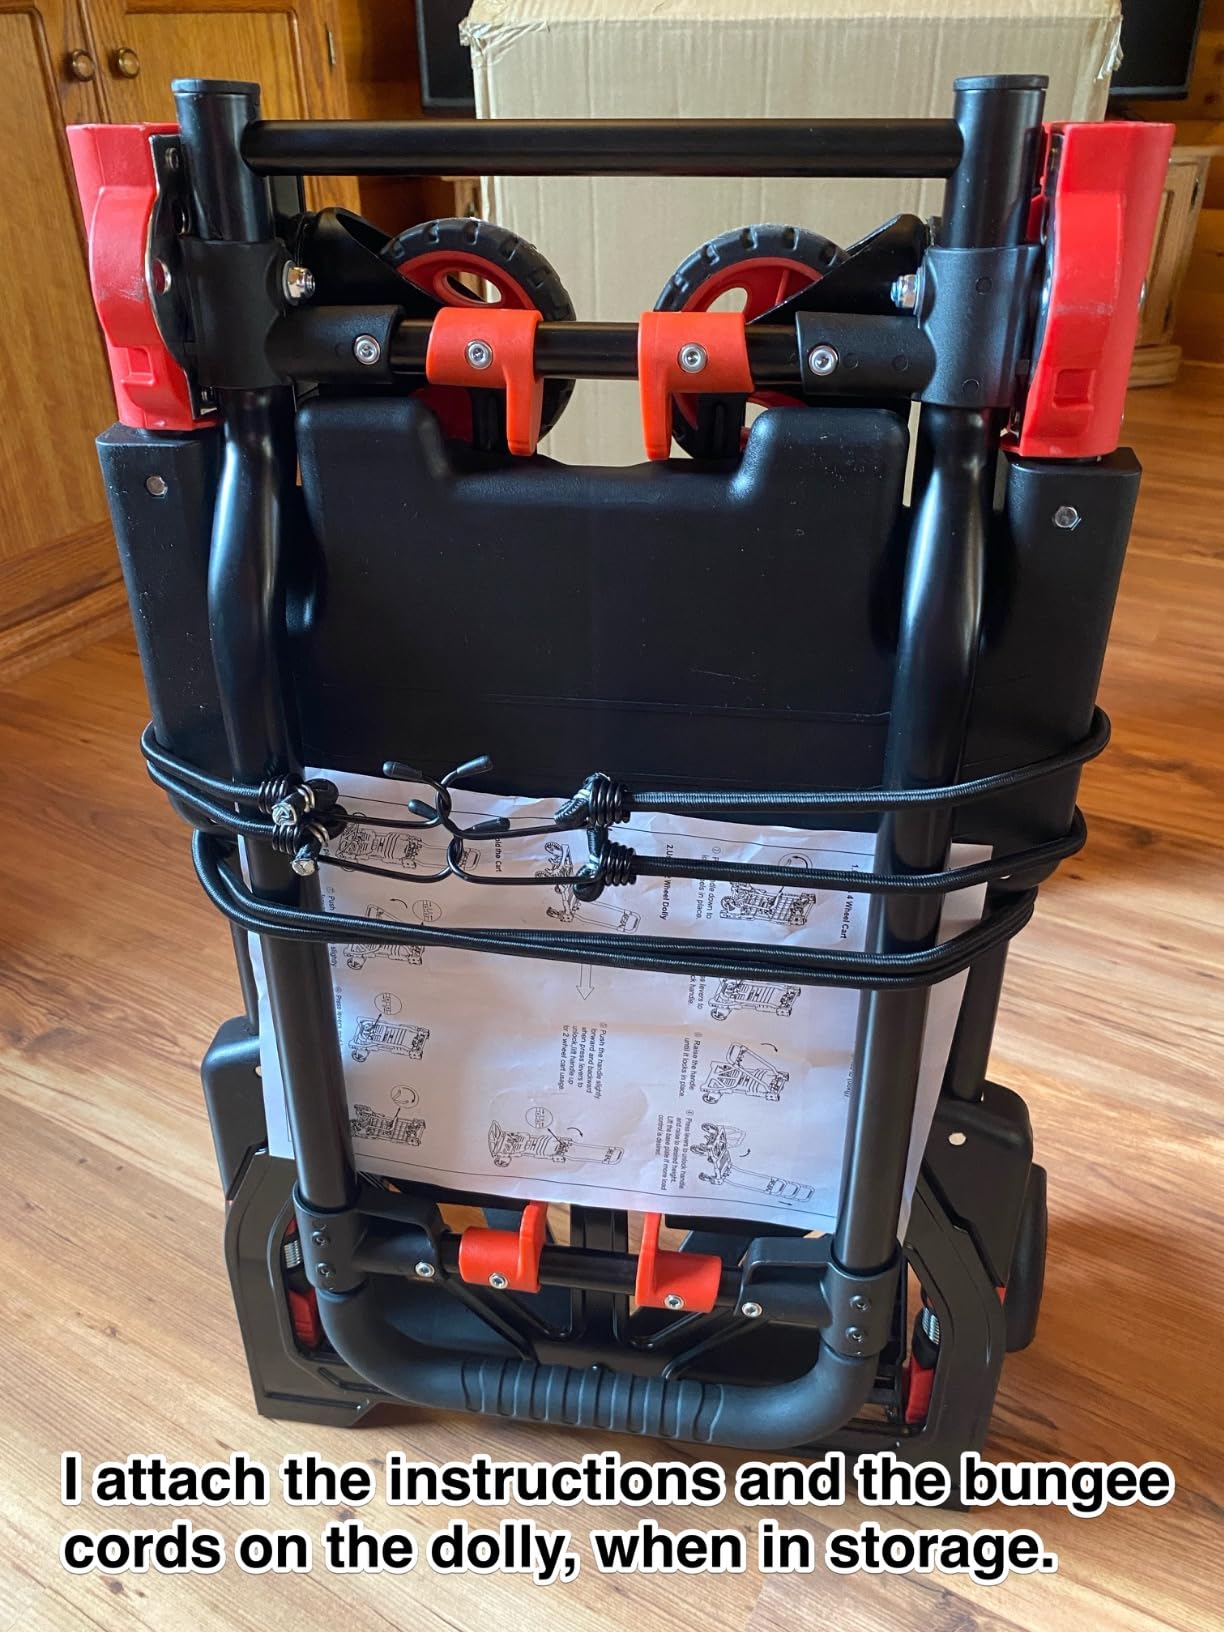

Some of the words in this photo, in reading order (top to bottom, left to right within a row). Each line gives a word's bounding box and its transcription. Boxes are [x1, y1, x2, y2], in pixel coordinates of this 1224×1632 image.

[495, 860, 503, 872] Cart
[663, 880, 671, 900] Wheel
[328, 895, 336, 911] Push
[659, 901, 669, 920] Dolly
[696, 899, 704, 920] place.
[707, 893, 716, 911] down
[842, 901, 853, 922] Wheel
[840, 923, 849, 939] Cart
[329, 946, 338, 967] slightly
[698, 983, 707, 1002] levers
[599, 1029, 607, 1046] Push
[560, 1038, 568, 1058] wheel
[578, 1043, 586, 1062] press
[692, 1040, 701, 1059] Raise
[569, 1055, 577, 1076] handle
[587, 1052, 595, 1065] and
[596, 1059, 604, 1079] handle
[586, 1065, 594, 1094] backward
[689, 1070, 697, 1090] handle
[593, 1080, 603, 1099] slightly
[685, 1117, 693, 1132] Press
[680, 1153, 688, 1169] unlock
[679, 1170, 687, 1189] handle
